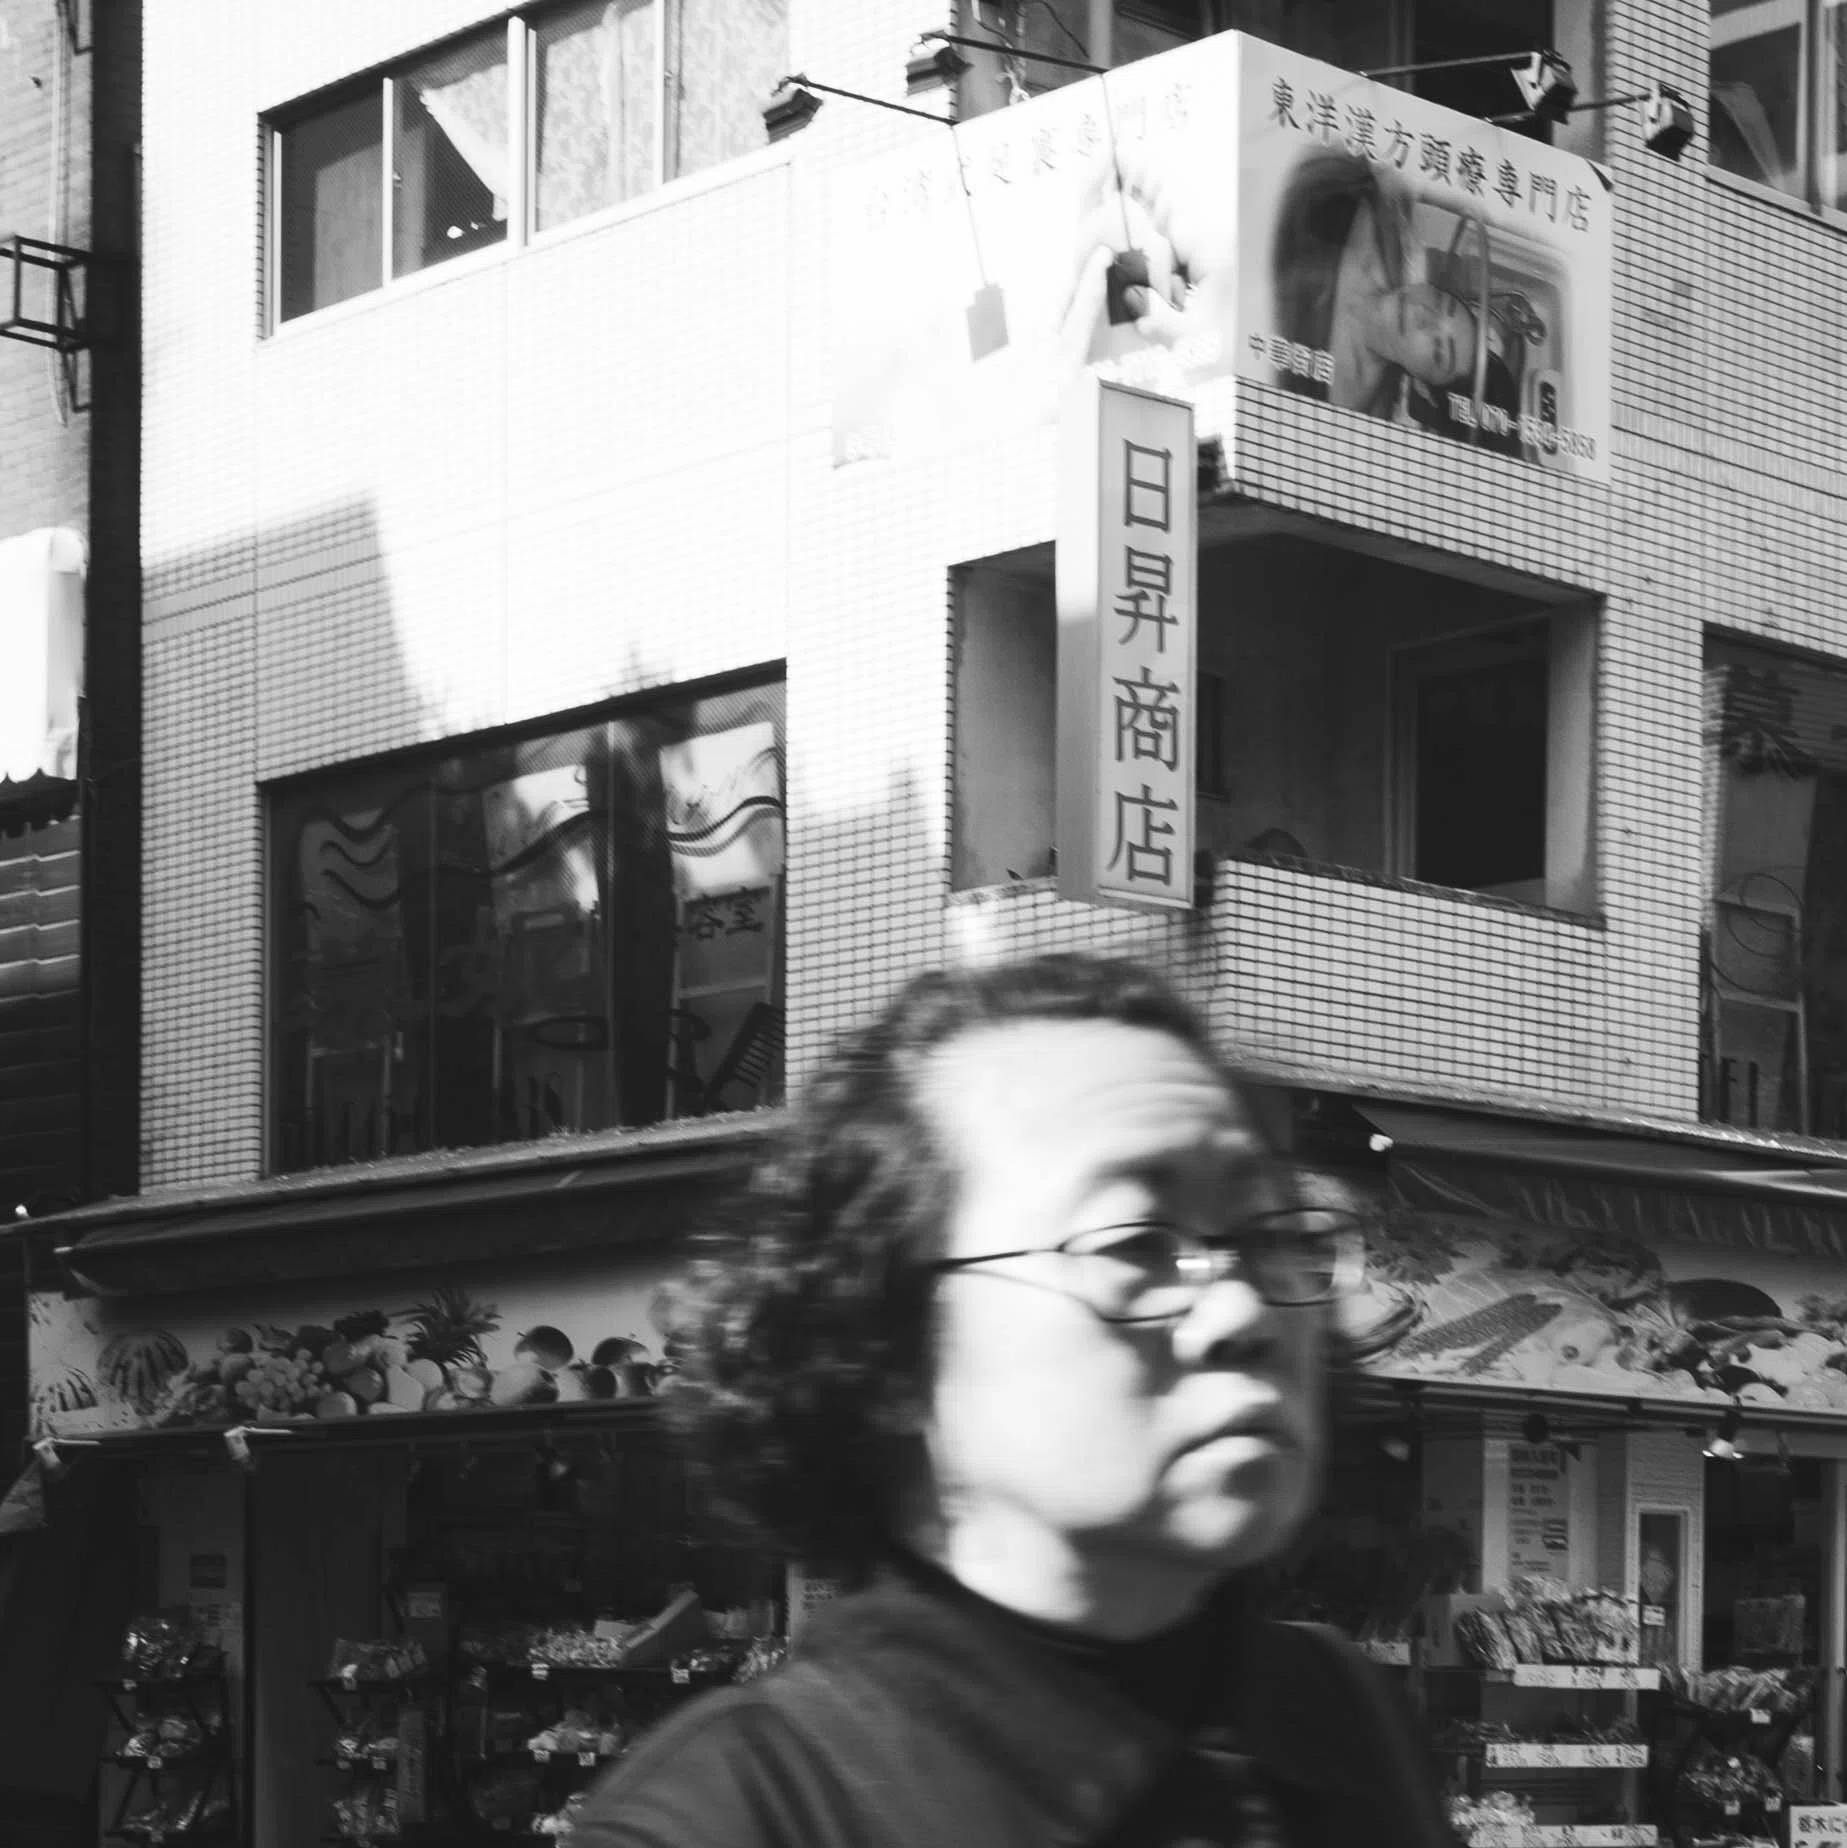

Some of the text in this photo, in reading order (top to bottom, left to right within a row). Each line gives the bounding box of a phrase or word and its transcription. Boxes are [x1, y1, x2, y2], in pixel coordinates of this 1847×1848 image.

[1268, 75, 1592, 236] 東洋漢方頭療専門店
[1106, 437, 1182, 888] 日昇商店
